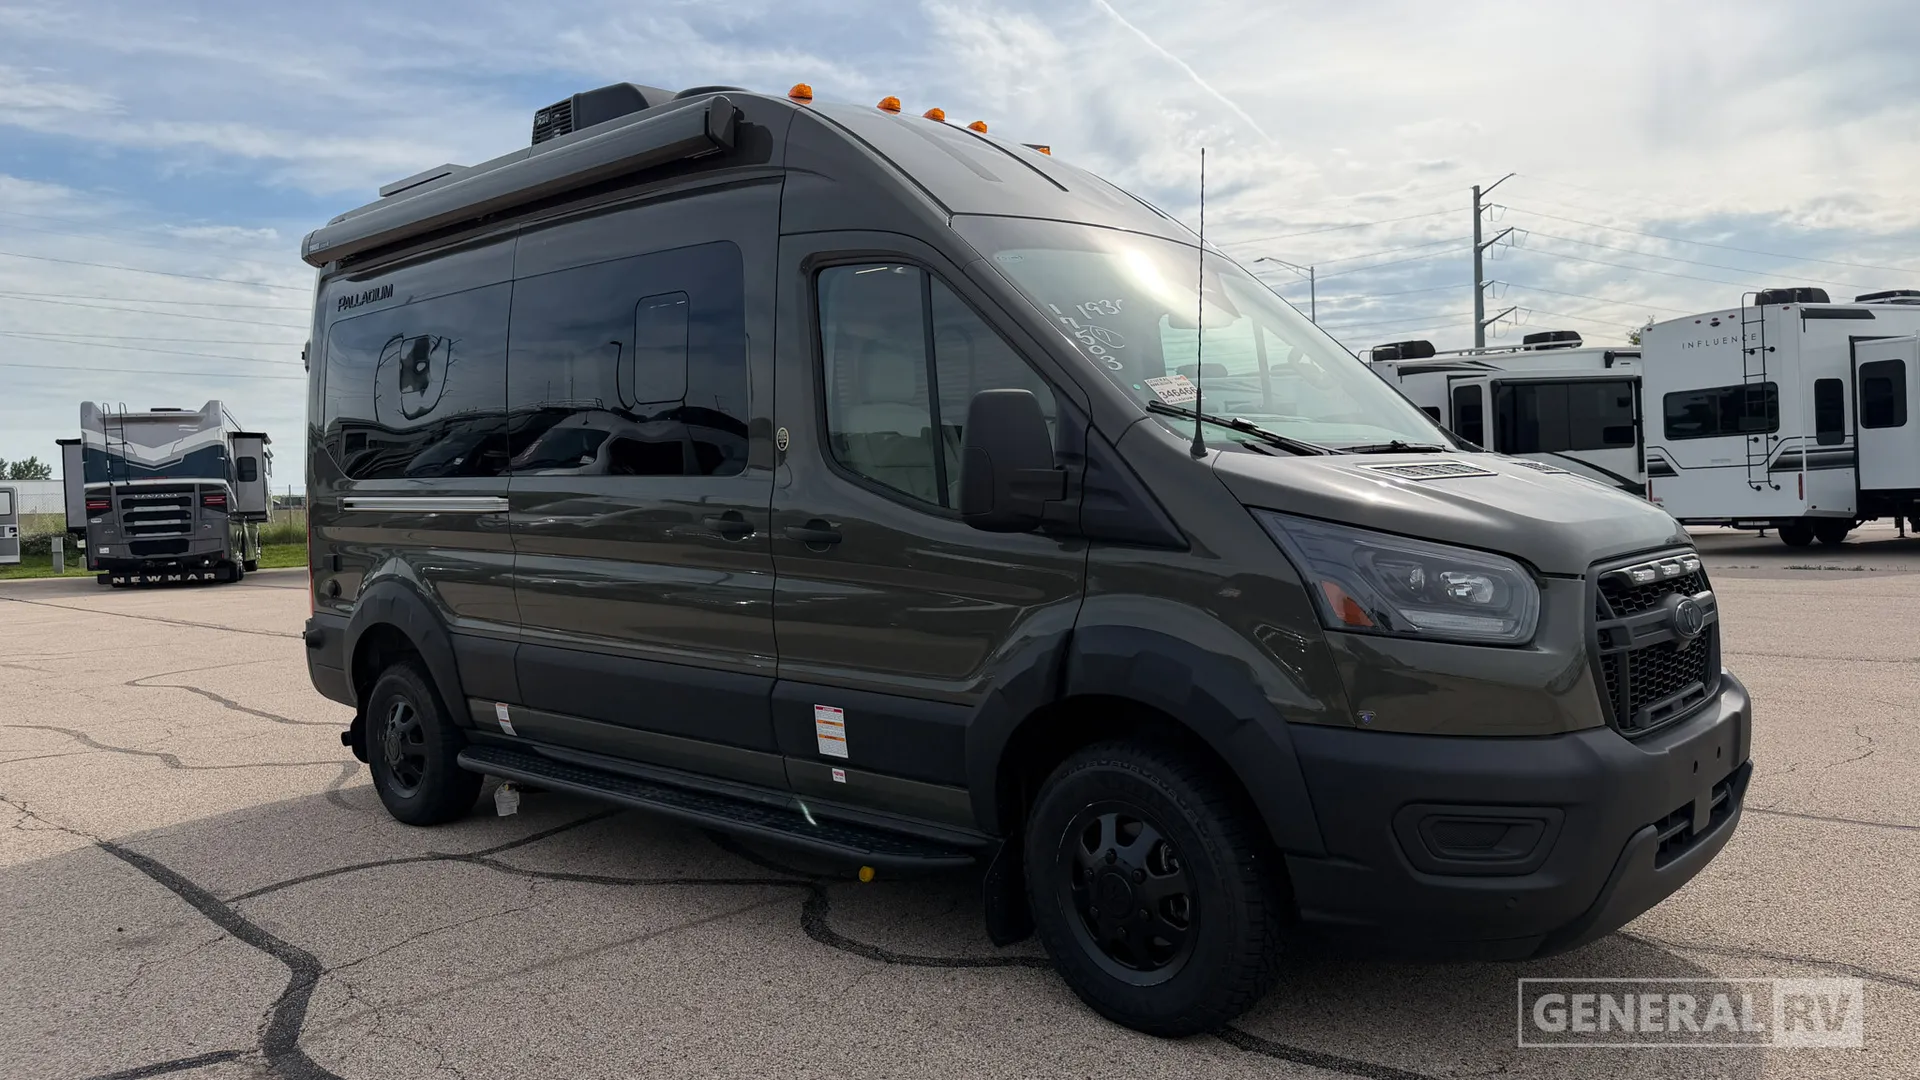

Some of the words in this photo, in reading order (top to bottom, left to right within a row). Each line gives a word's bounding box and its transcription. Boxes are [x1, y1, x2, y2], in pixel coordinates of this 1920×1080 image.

[338, 284, 394, 312] PALLADIUM
[1682, 333, 1757, 349] INFLUENCE
[113, 573, 216, 584] NEWMAR
